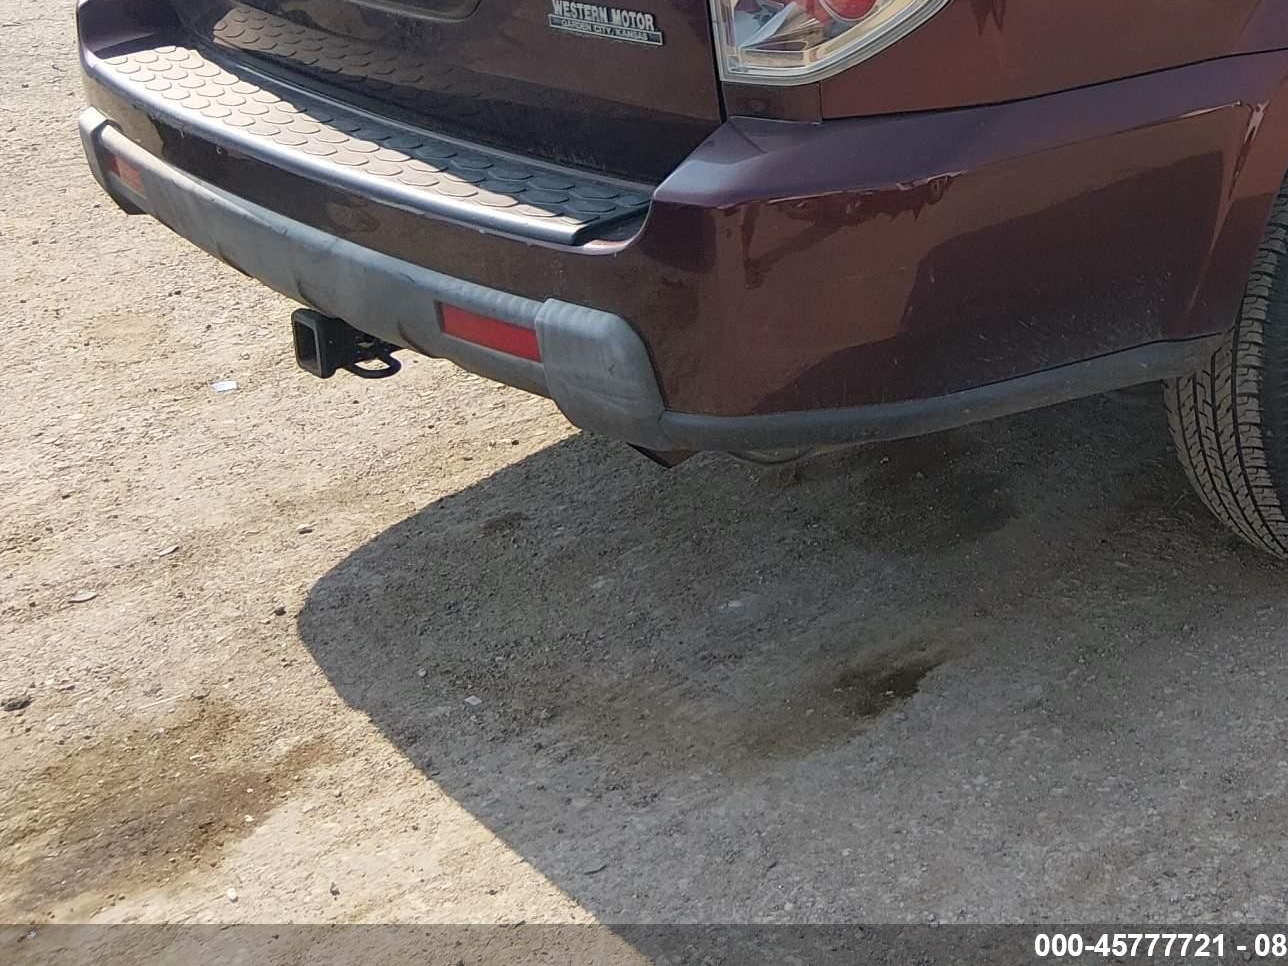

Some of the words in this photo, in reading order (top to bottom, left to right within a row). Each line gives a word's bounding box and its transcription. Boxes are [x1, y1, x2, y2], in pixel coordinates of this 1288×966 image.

[552, 0, 608, 23] WESTERN
[611, 8, 655, 32] MOTOR
[561, 19, 592, 32] GARDEN
[615, 27, 648, 41] KANSAS
